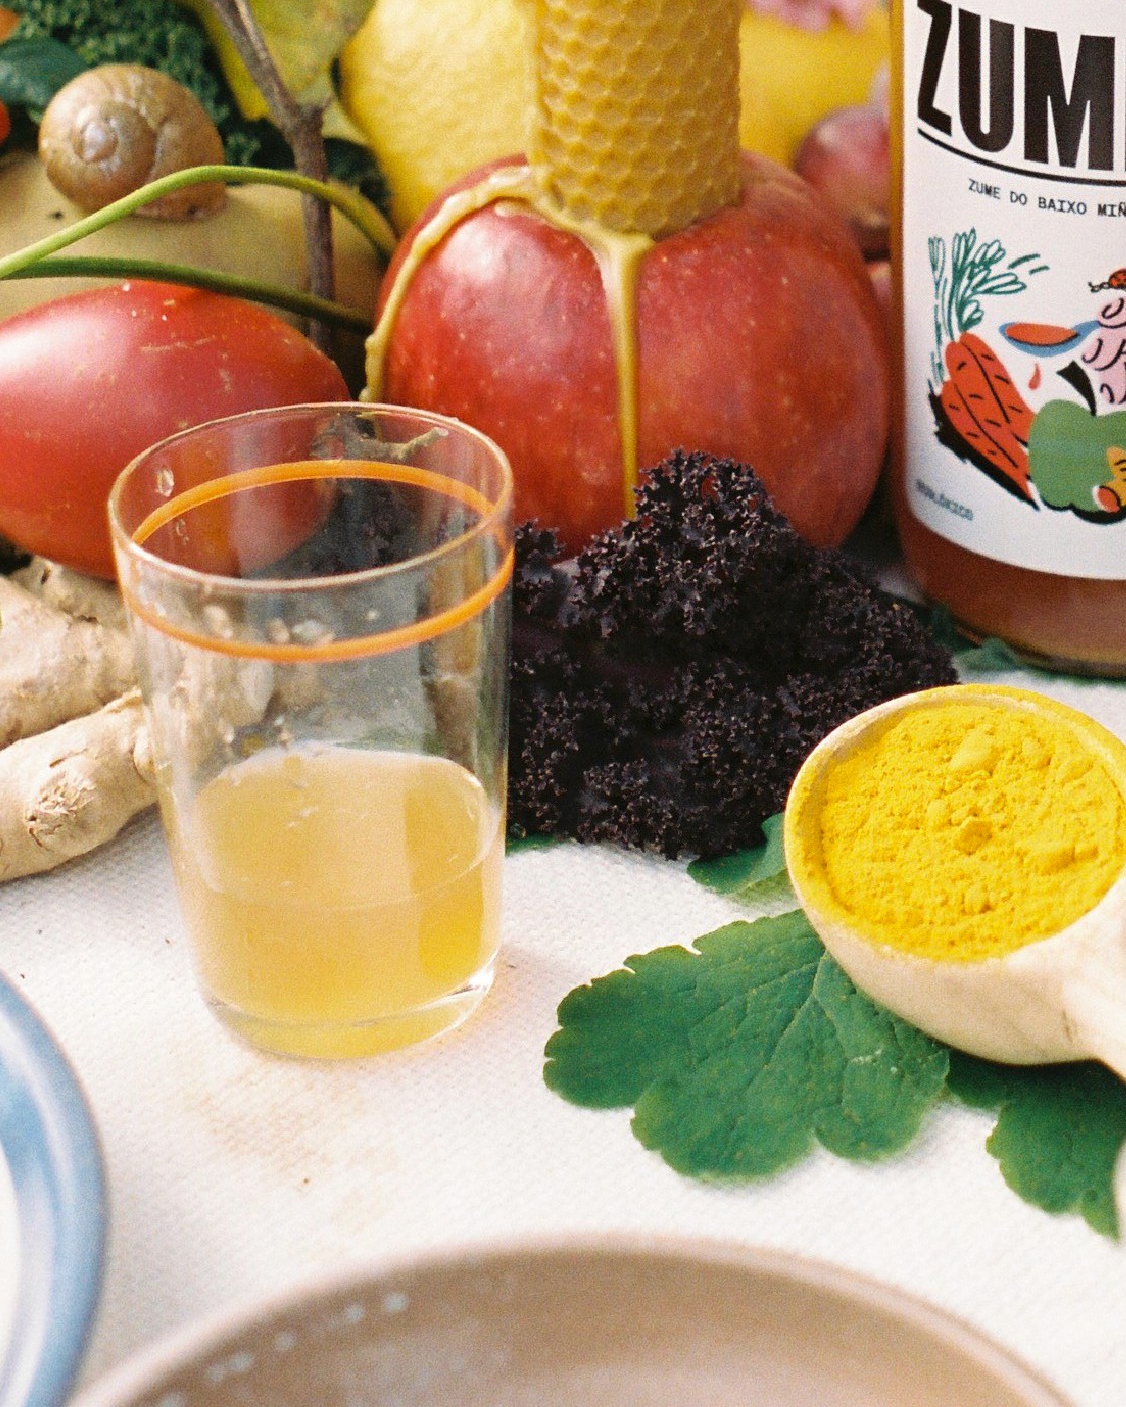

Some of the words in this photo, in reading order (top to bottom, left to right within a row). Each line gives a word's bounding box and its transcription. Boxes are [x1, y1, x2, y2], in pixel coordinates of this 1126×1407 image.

[968, 178, 1001, 199] ZUME
[1009, 191, 1028, 205] DO
[1038, 197, 1087, 215] BAIXO
